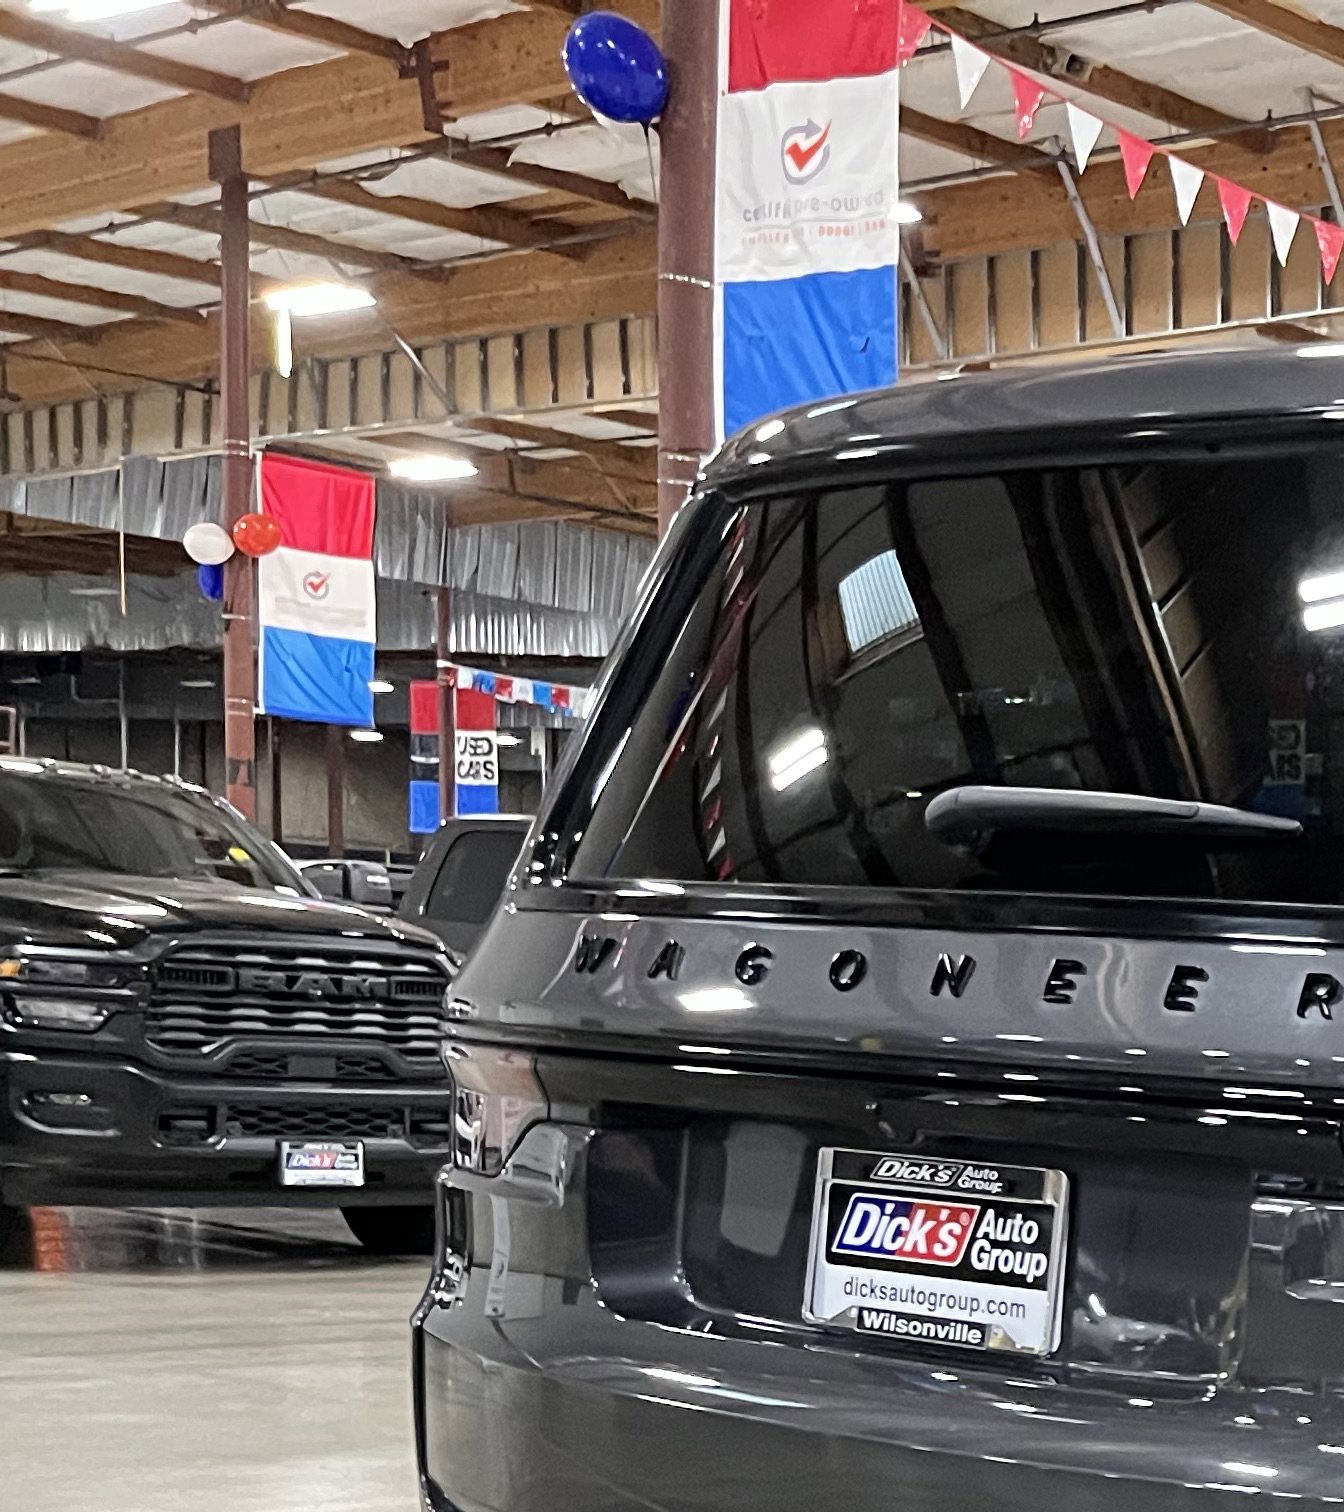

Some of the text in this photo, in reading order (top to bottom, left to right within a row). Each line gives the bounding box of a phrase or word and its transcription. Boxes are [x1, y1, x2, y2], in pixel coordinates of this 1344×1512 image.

[877, 1159, 955, 1184] Dick's
[963, 1166, 999, 1181] Auto
[842, 1202, 964, 1258] Dick's
[975, 1208, 1040, 1245] Auto
[969, 1238, 1049, 1284] Group
[843, 1276, 1027, 1319] dicksautogroup.com
[861, 1309, 983, 1345] Wilsonville
